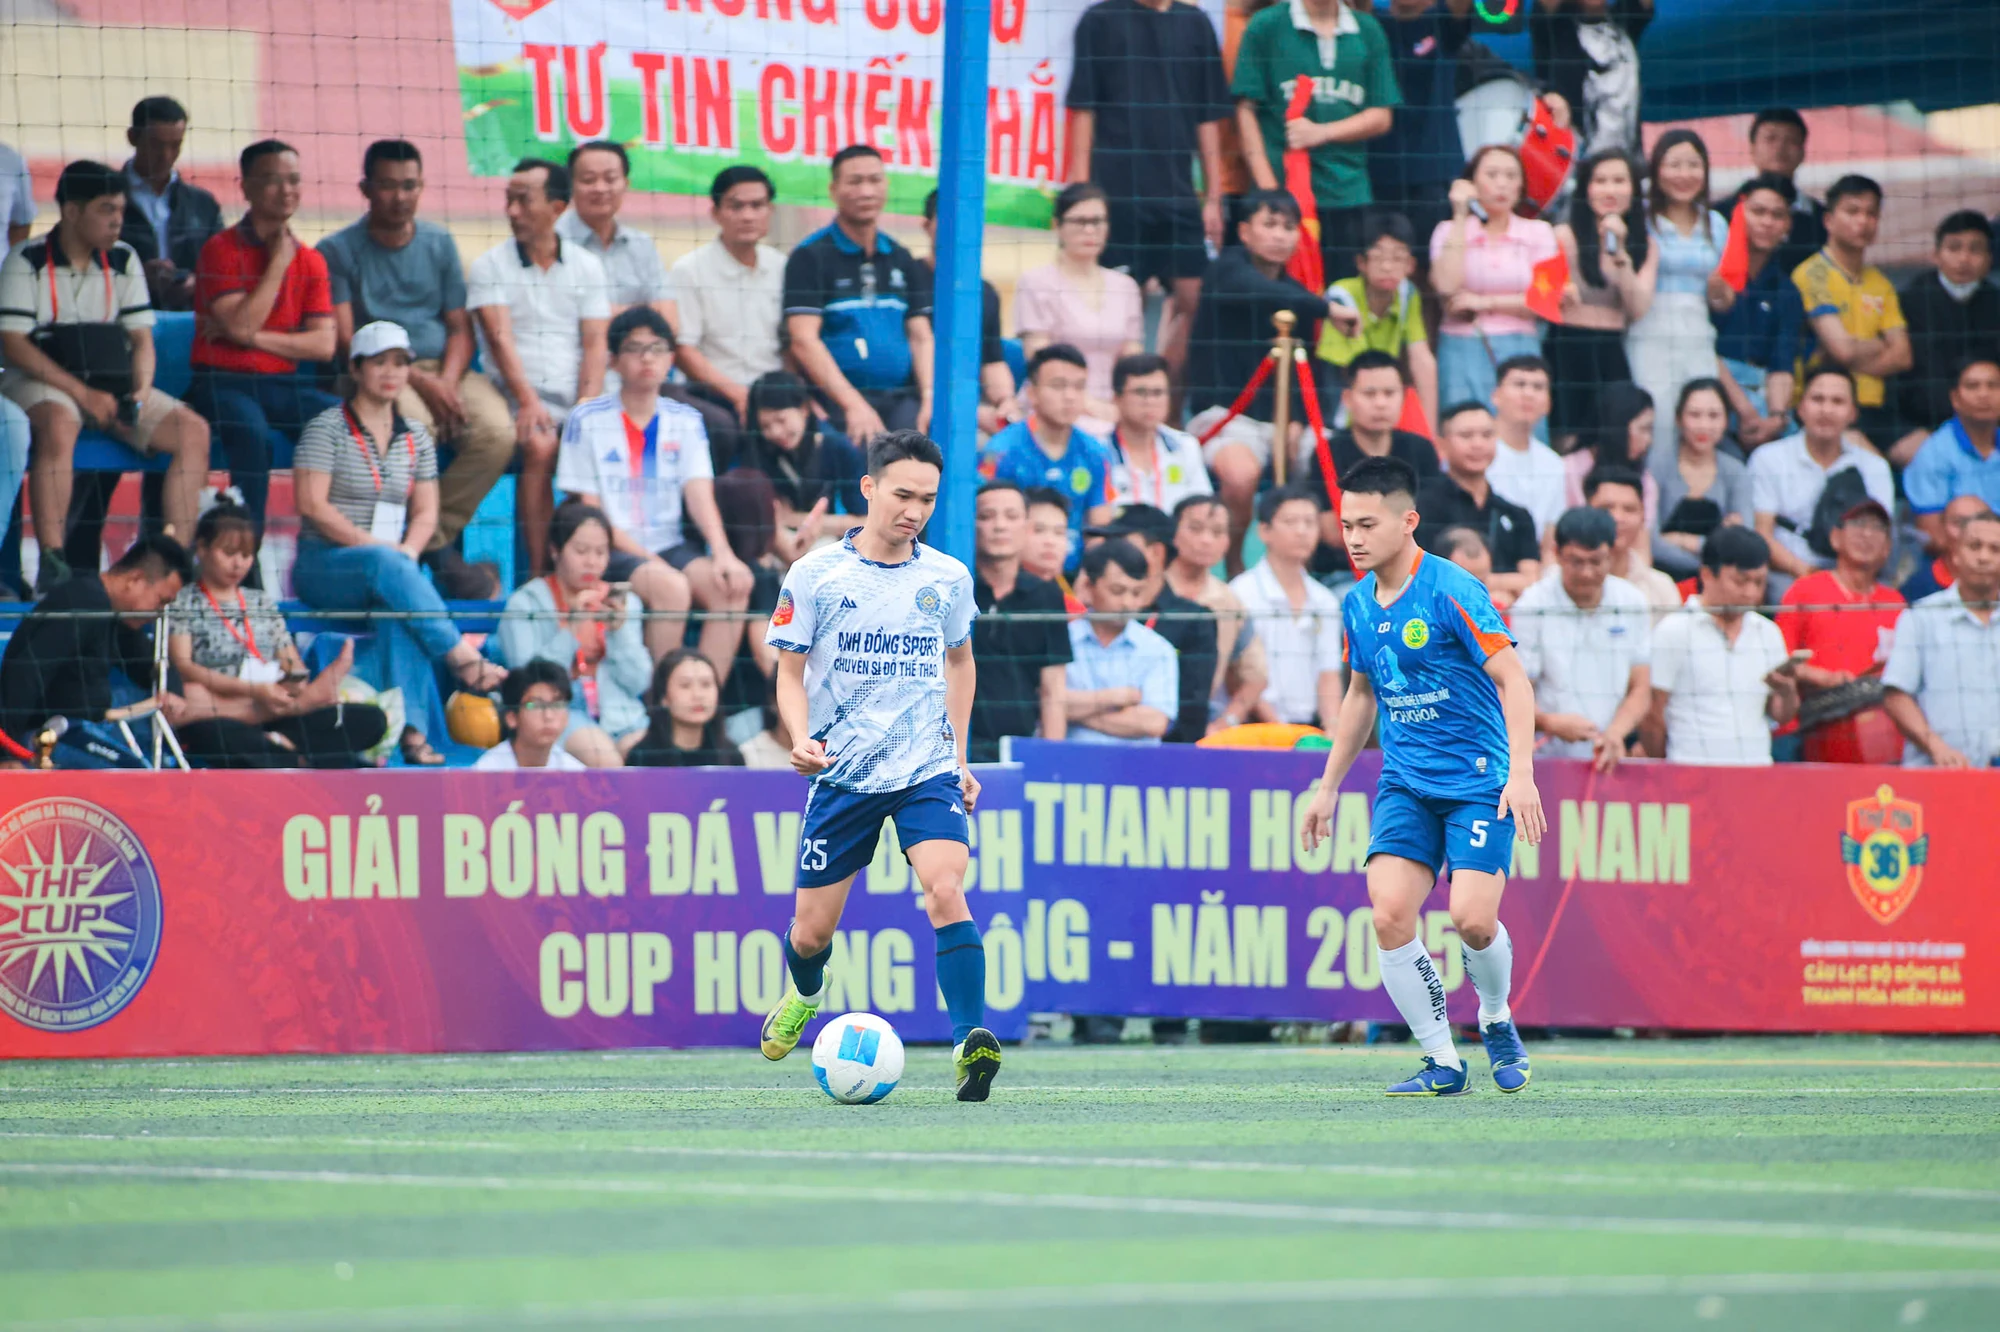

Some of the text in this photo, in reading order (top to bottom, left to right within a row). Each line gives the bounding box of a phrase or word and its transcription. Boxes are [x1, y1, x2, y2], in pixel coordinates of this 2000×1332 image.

[632, 51, 732, 149] TIN
[760, 53, 933, 168] CHIẾN
[864, 626, 900, 655] ĐỒNG
[282, 794, 420, 901] GIẢI
[442, 800, 626, 898] BÓNG
[646, 799, 739, 896] ĐÁ
[753, 811, 801, 895] V
[1024, 781, 1230, 870] THANH
[1559, 799, 1691, 884] NAM
[1469, 820, 1489, 848] 5
[801, 838, 828, 871] 25
[19, 903, 104, 935] CUP
[539, 931, 674, 1018] CUP
[693, 928, 916, 1015] HONG
[936, 898, 1090, 1013] ÔNG
[1151, 889, 1288, 988] NĂM
[1306, 905, 1464, 993] 205
[1433, 1006, 1446, 1021] FC
[844, 1079, 866, 1098] molten
